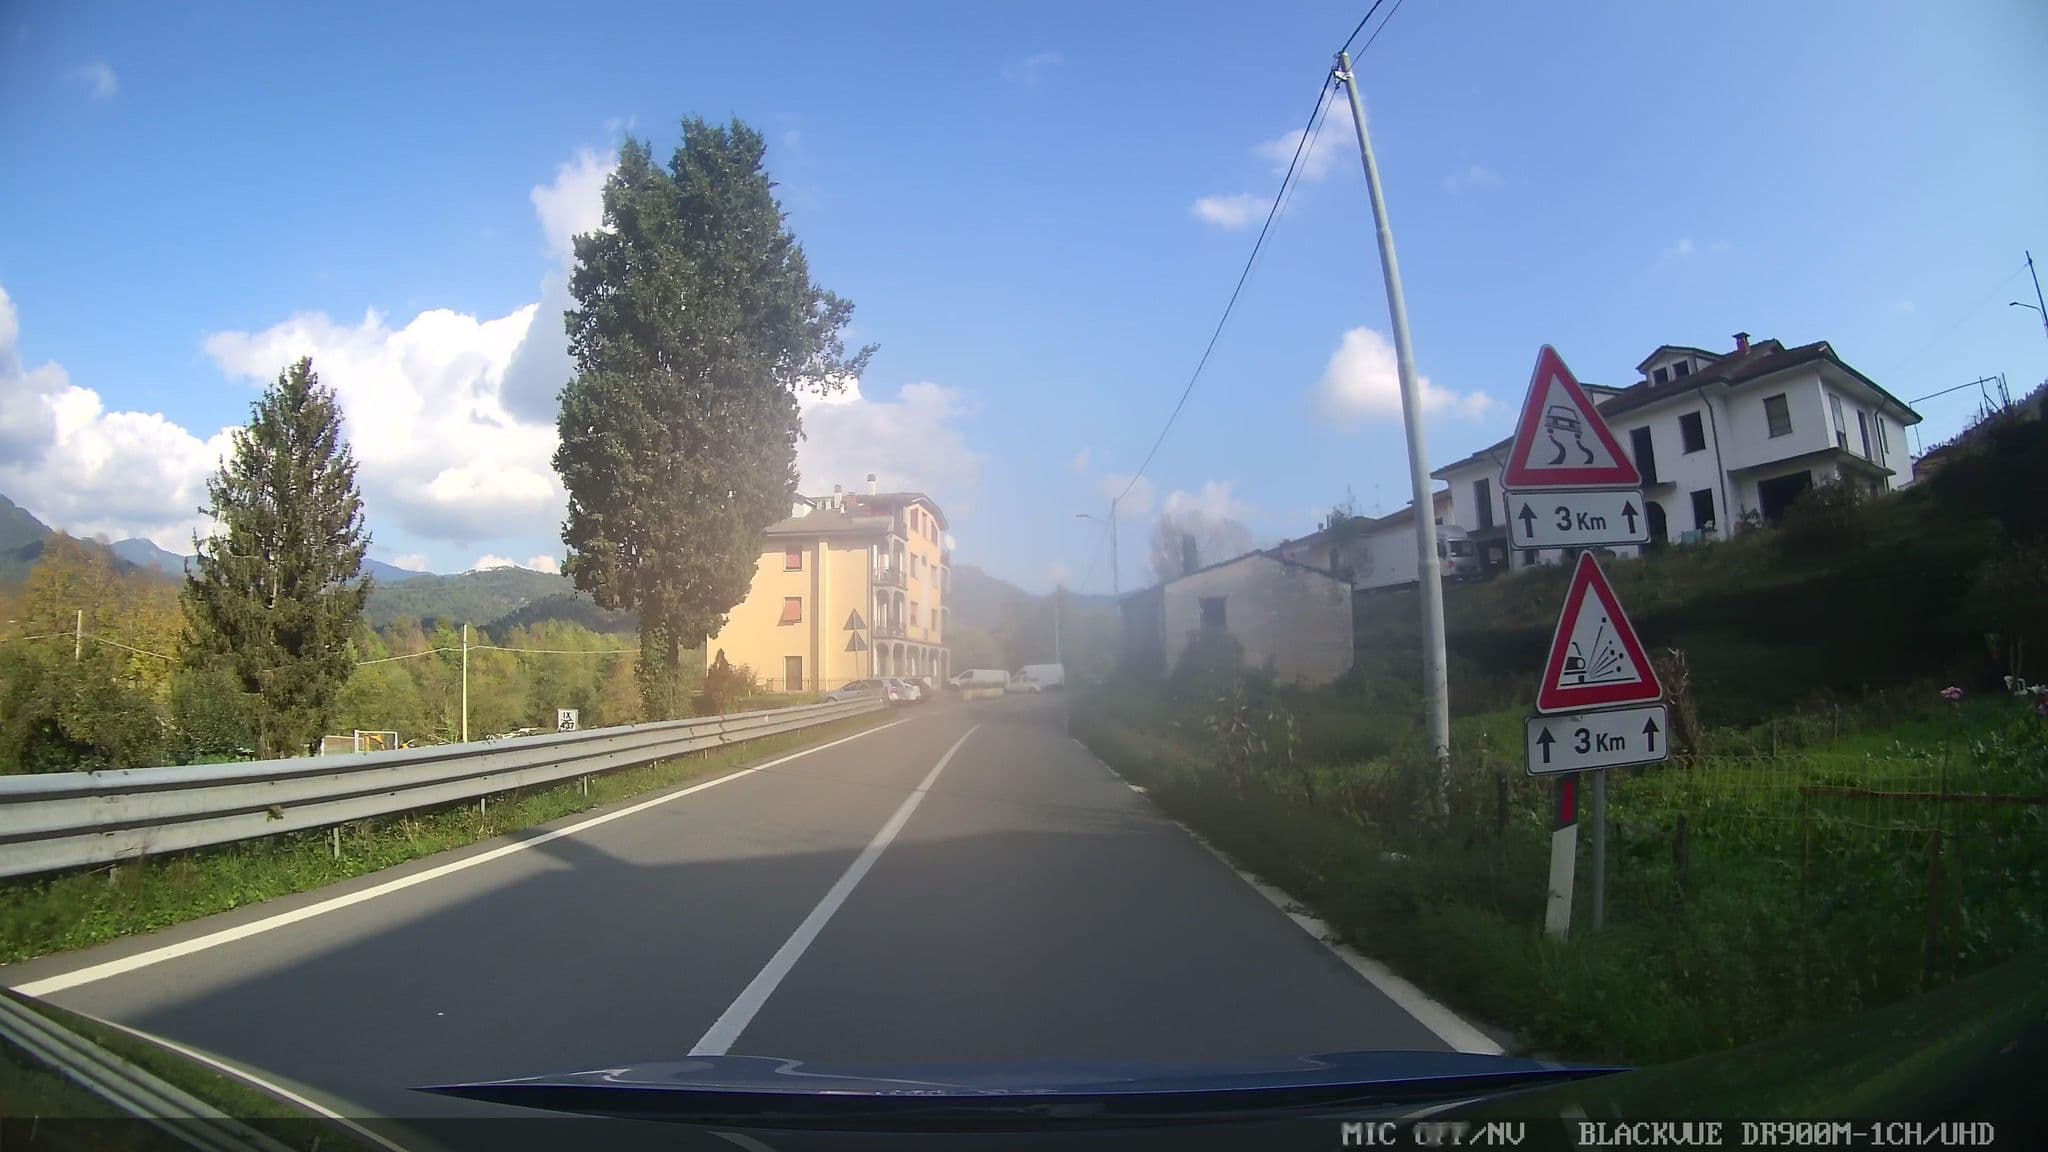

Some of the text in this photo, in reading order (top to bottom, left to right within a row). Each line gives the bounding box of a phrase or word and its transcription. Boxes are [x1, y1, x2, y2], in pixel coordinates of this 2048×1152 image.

[1555, 506, 1607, 531] 3 Km
[1574, 728, 1625, 754] 3 Km
